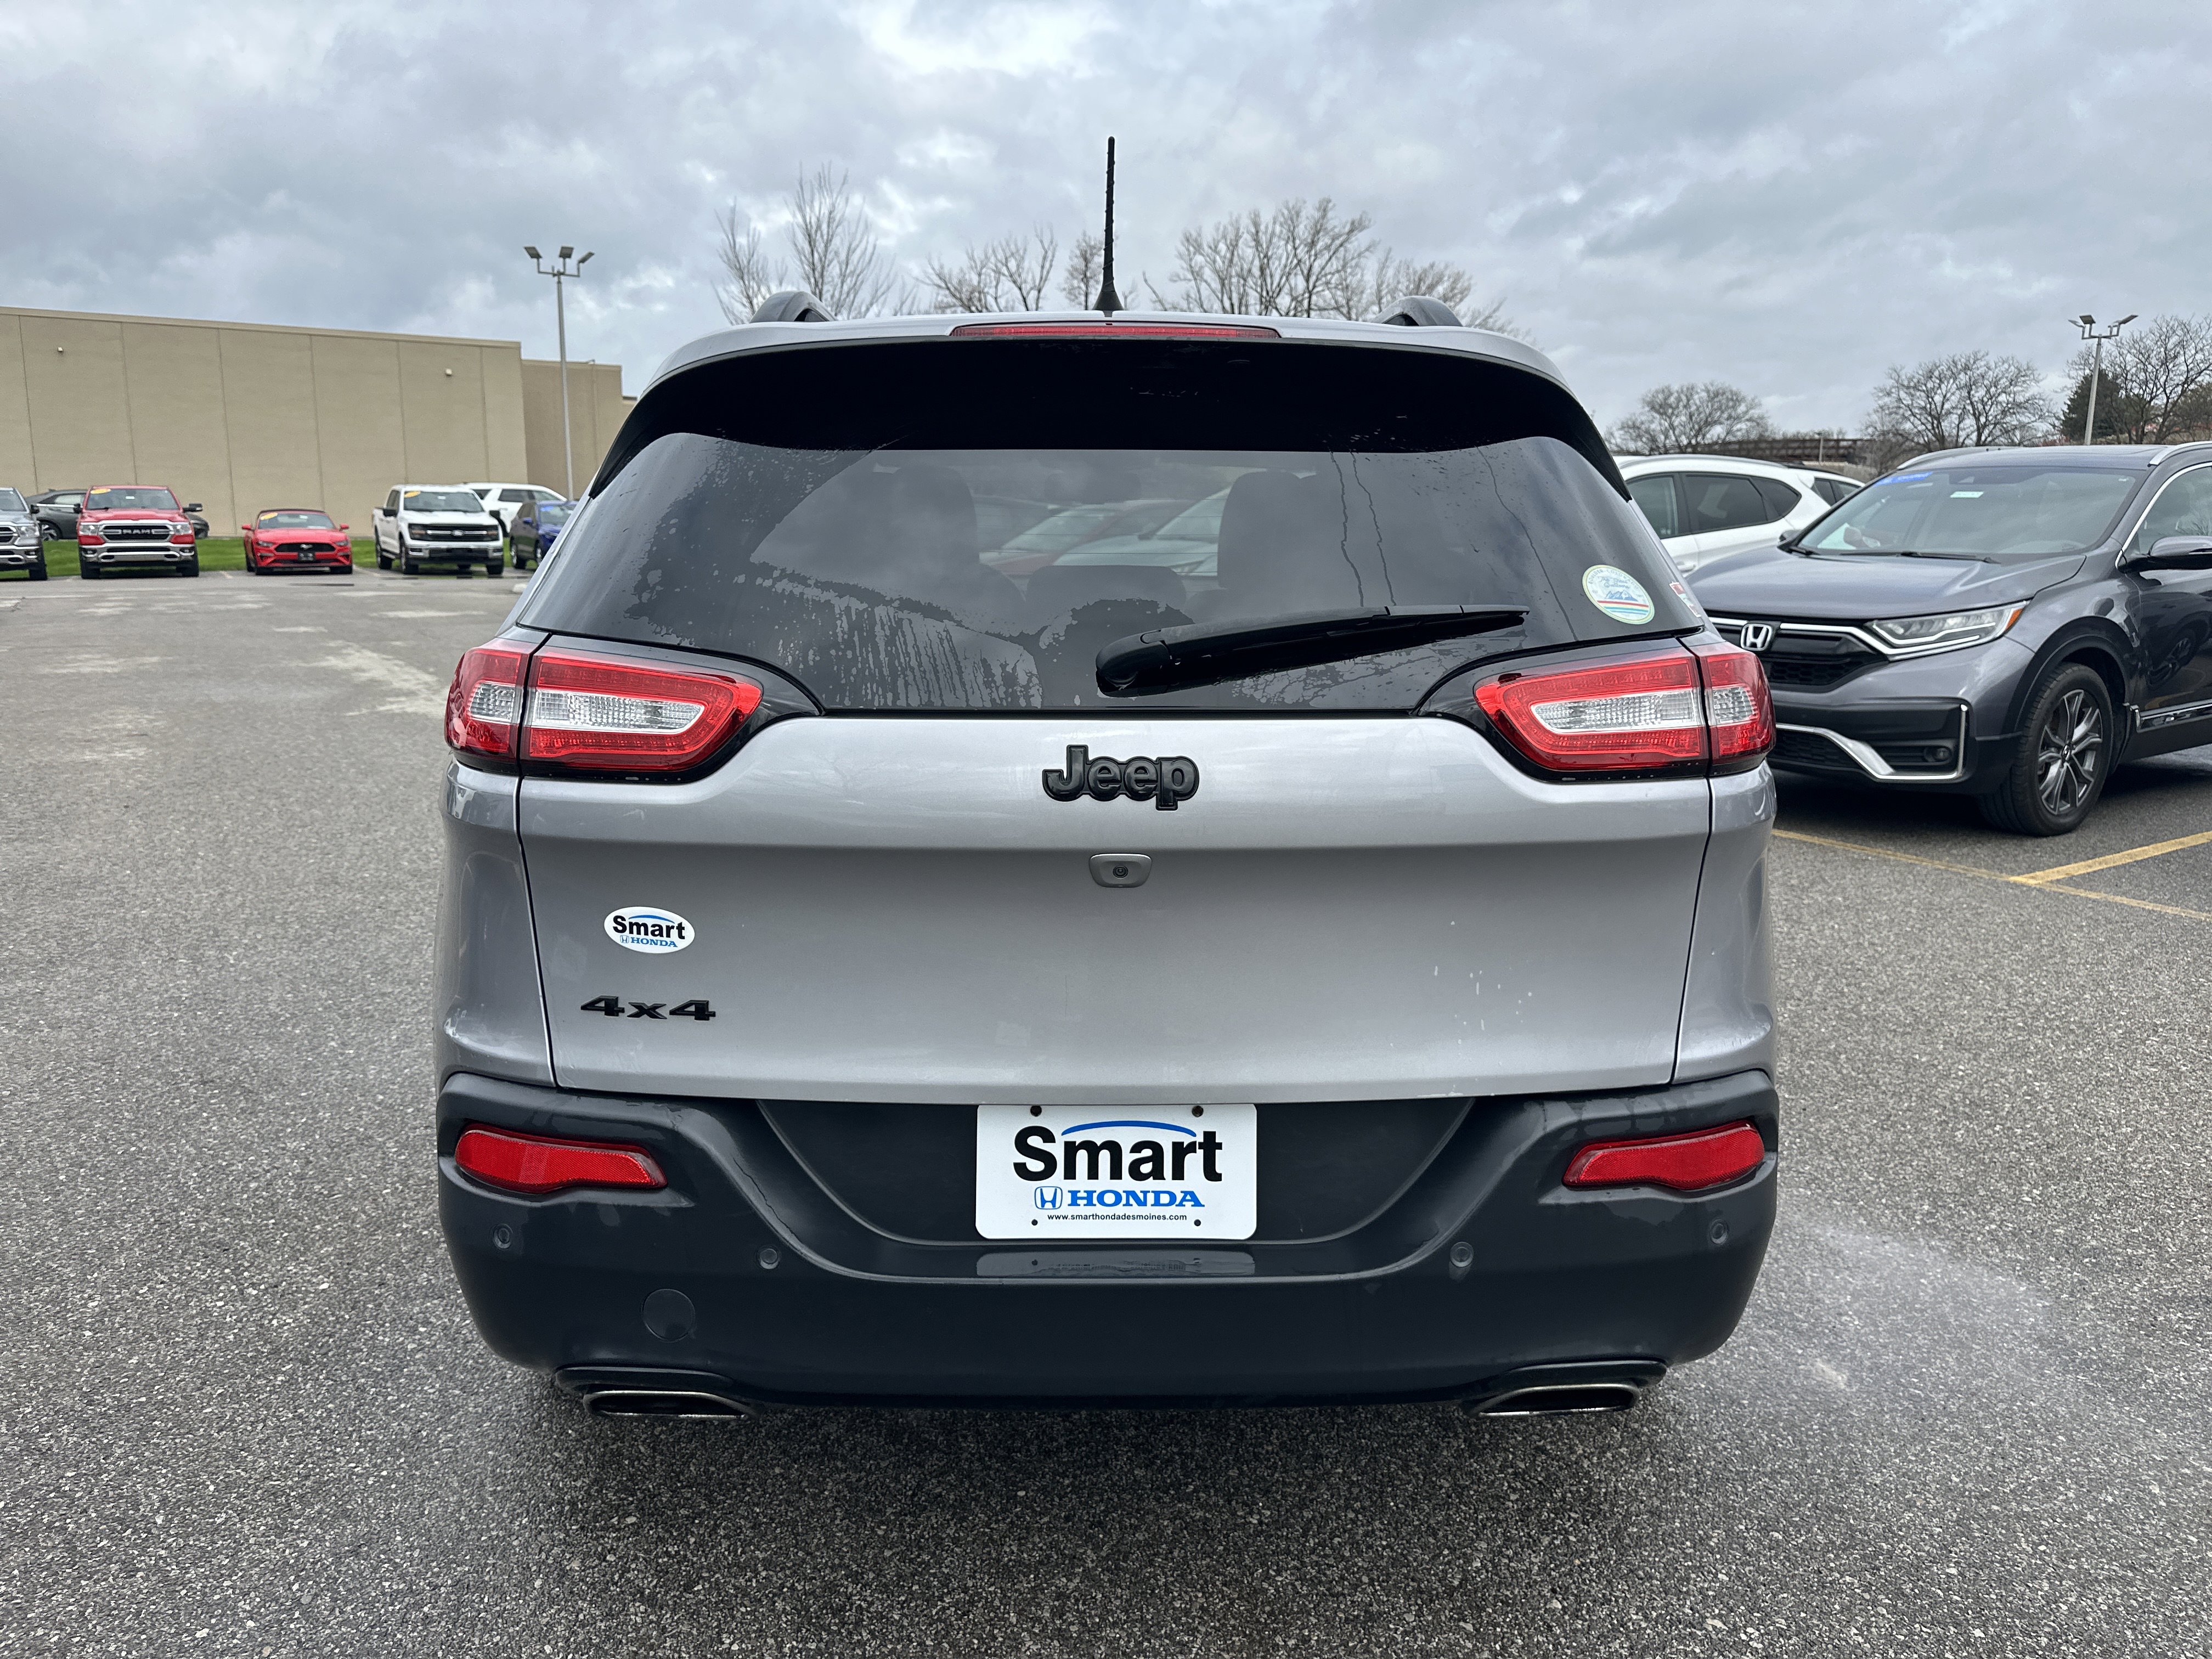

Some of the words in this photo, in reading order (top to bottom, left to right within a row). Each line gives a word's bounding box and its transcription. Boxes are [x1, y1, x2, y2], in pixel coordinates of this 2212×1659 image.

[1042, 744, 1200, 811] Jeep
[613, 915, 685, 940] Smart
[631, 937, 678, 947] HONDA
[580, 995, 716, 1021] 4x4
[1013, 1125, 1223, 1182] Smart
[1067, 1189, 1205, 1207] HONDA
